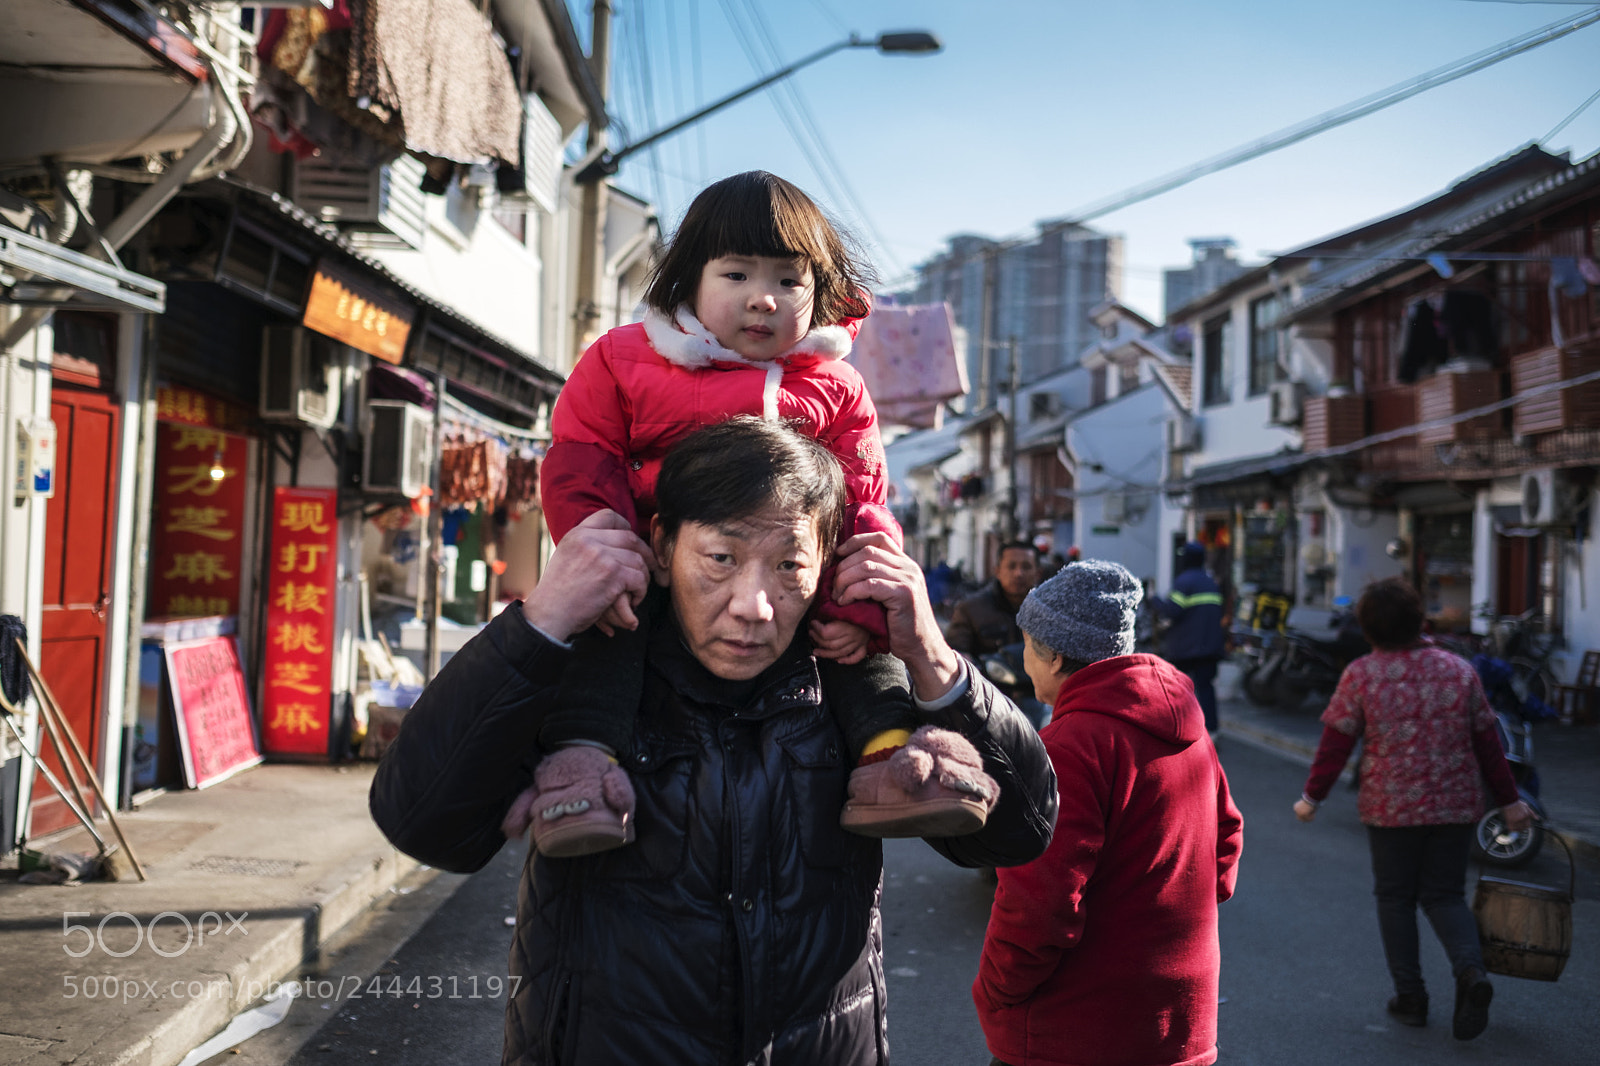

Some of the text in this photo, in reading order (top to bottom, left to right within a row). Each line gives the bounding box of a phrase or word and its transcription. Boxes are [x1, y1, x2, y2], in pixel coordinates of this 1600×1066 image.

[270, 501, 331, 735] 现打核桃芝麻
